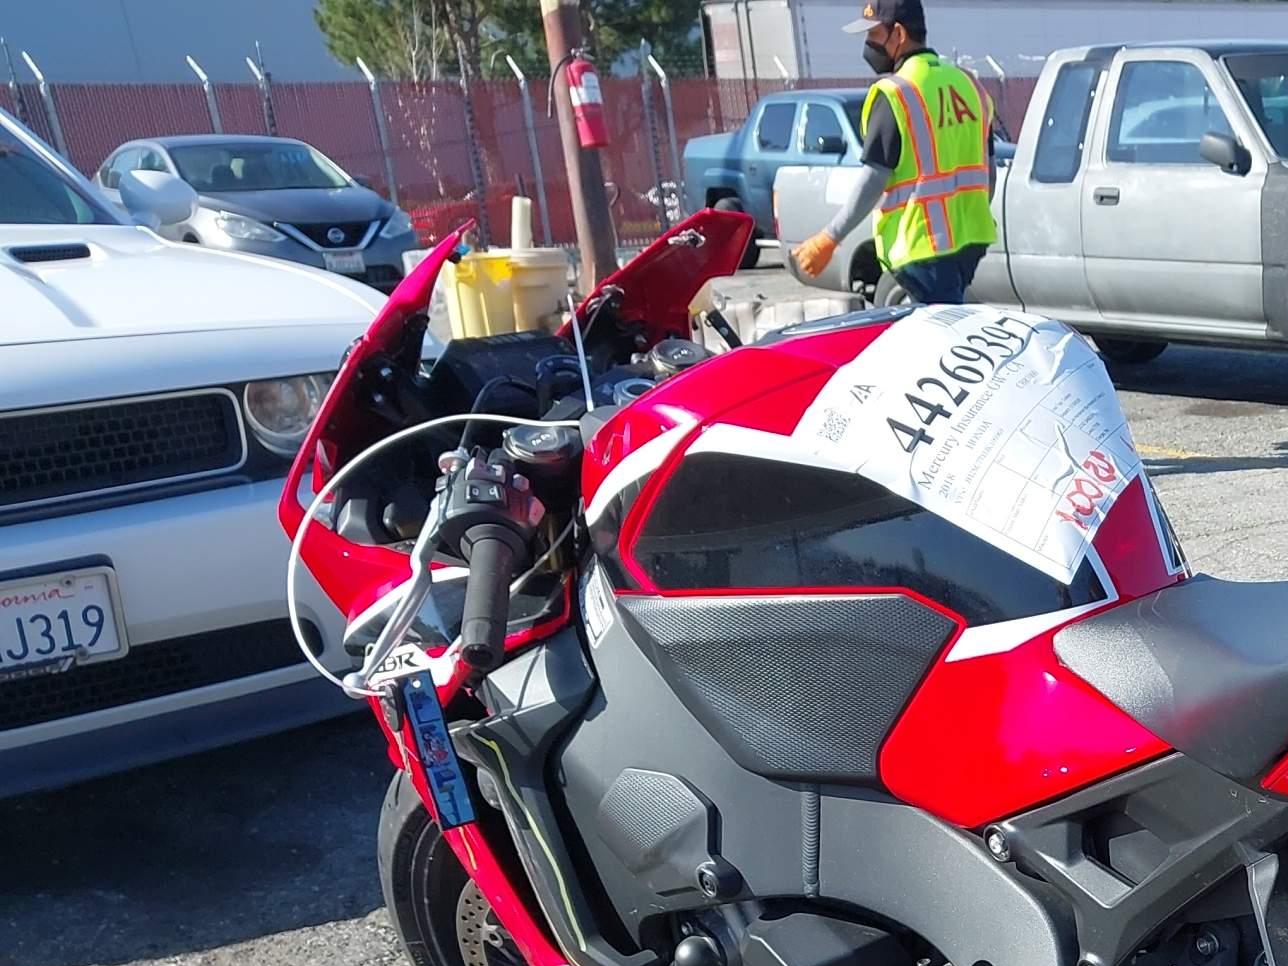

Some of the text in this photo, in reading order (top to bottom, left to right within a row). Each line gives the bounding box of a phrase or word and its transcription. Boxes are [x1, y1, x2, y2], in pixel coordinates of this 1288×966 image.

[886, 316, 1040, 454] 44269397
[917, 434, 961, 490] Mercury
[950, 388, 995, 434] Insurance
[1007, 359, 1025, 376] CA
[0, 604, 104, 661] J319
